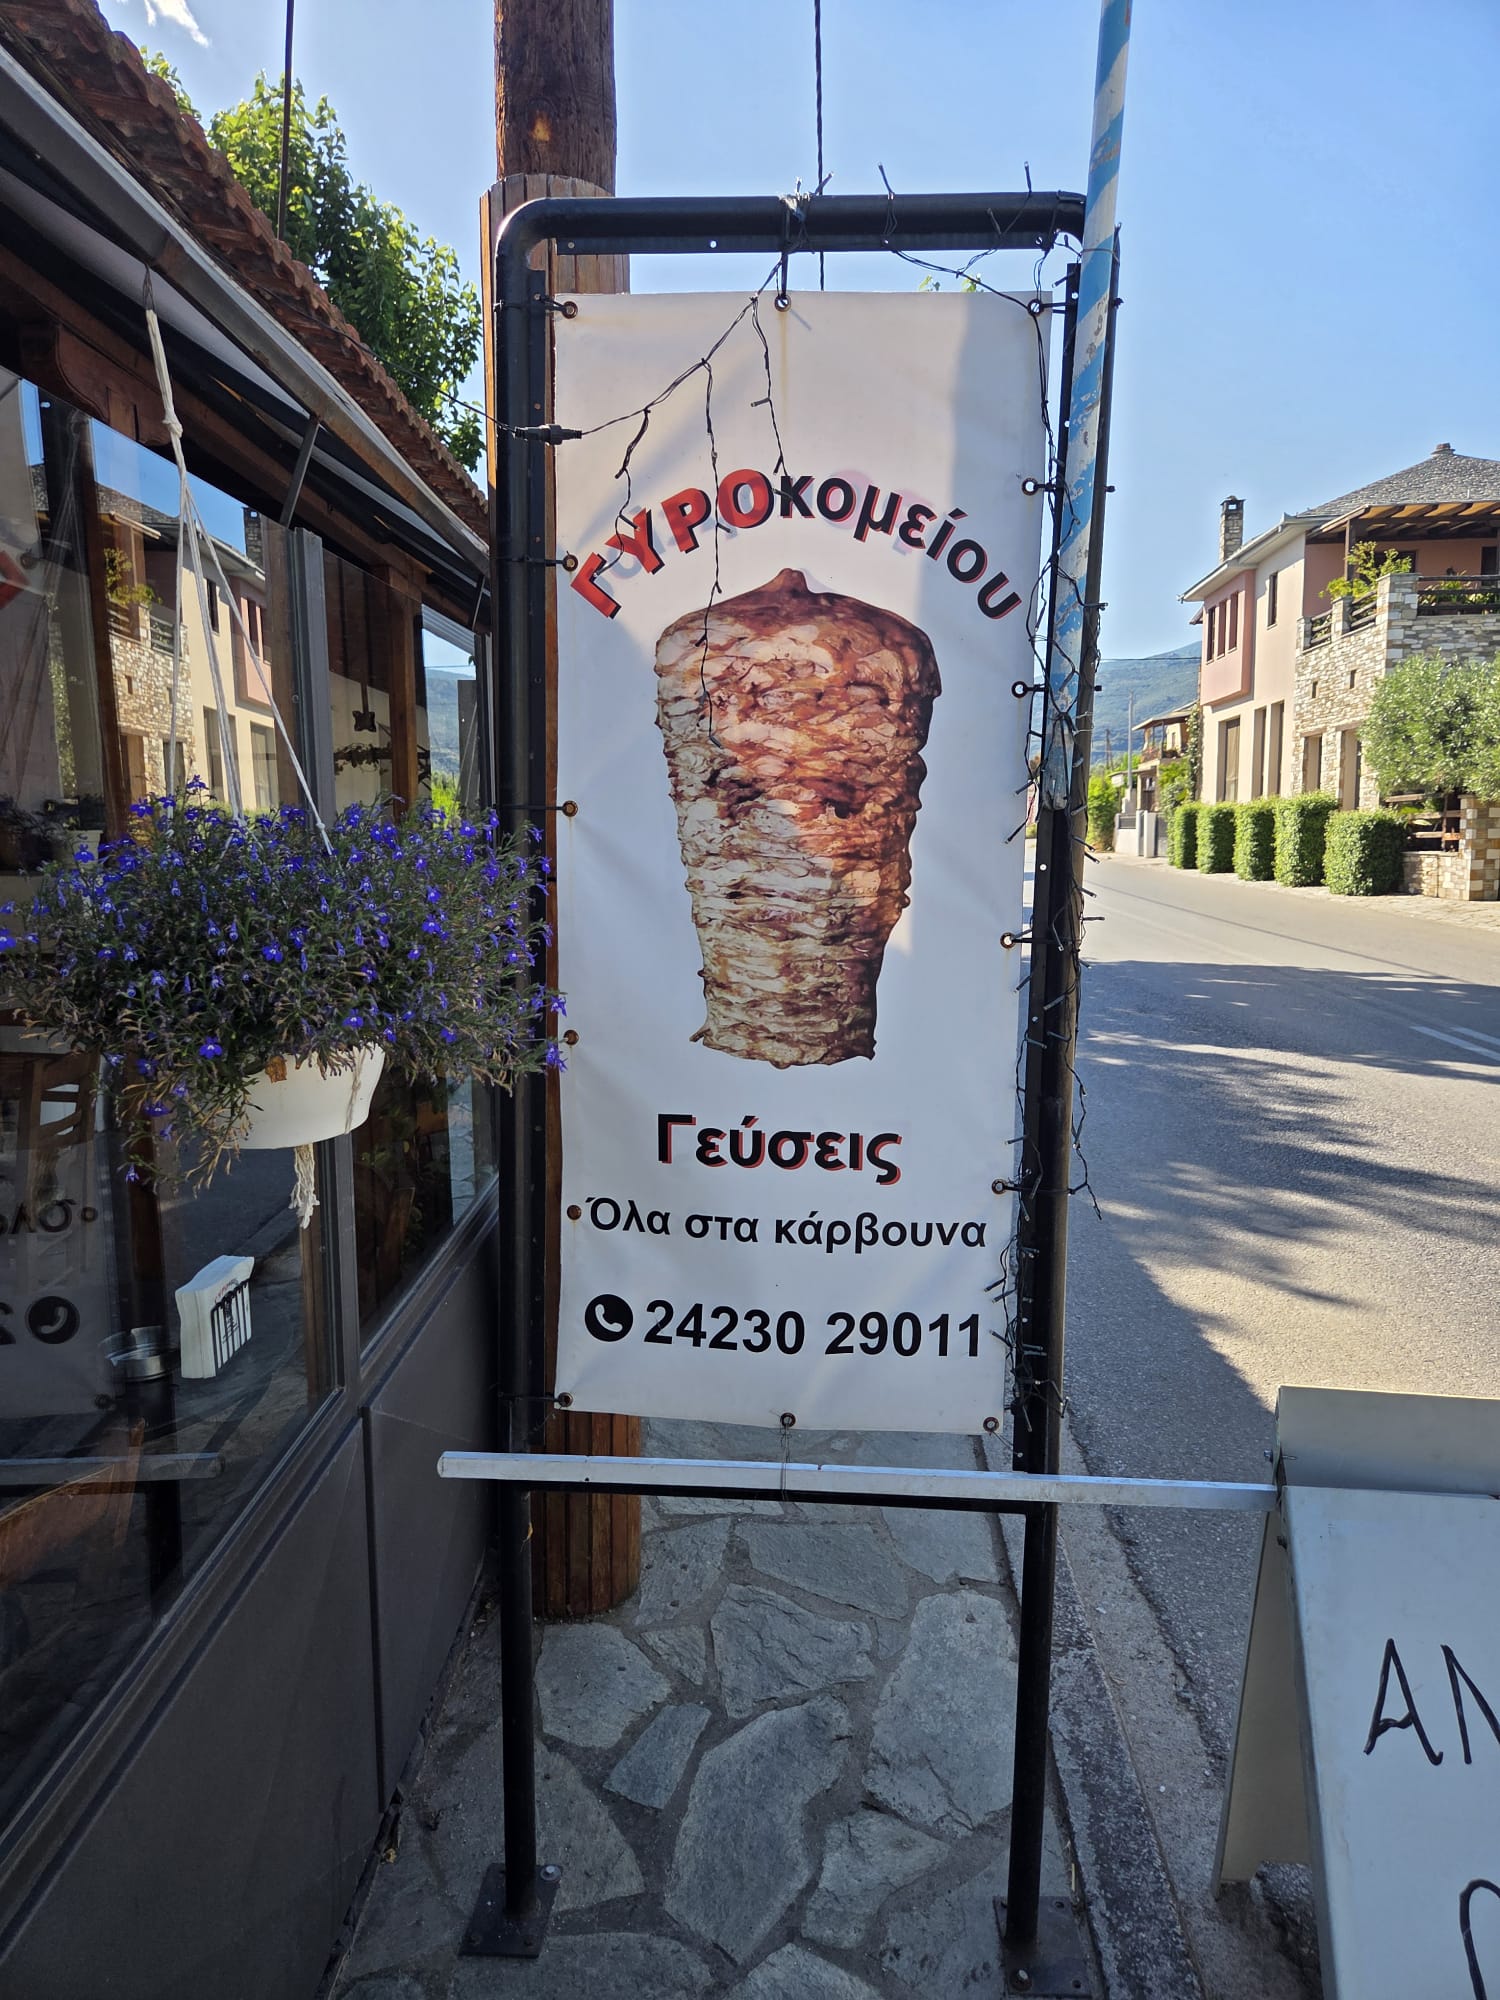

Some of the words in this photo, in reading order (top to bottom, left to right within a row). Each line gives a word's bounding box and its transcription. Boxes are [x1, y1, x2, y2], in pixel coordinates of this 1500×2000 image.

[570, 468, 1022, 620] ΓΥΡΟκομείου
[657, 1113, 903, 1185] Γεύσεις
[585, 1197, 671, 1236] Όλα
[684, 1214, 759, 1242] στα
[774, 1210, 987, 1254] κάρβουνα
[643, 1300, 806, 1355] 24230
[825, 1311, 979, 1357] 29011
